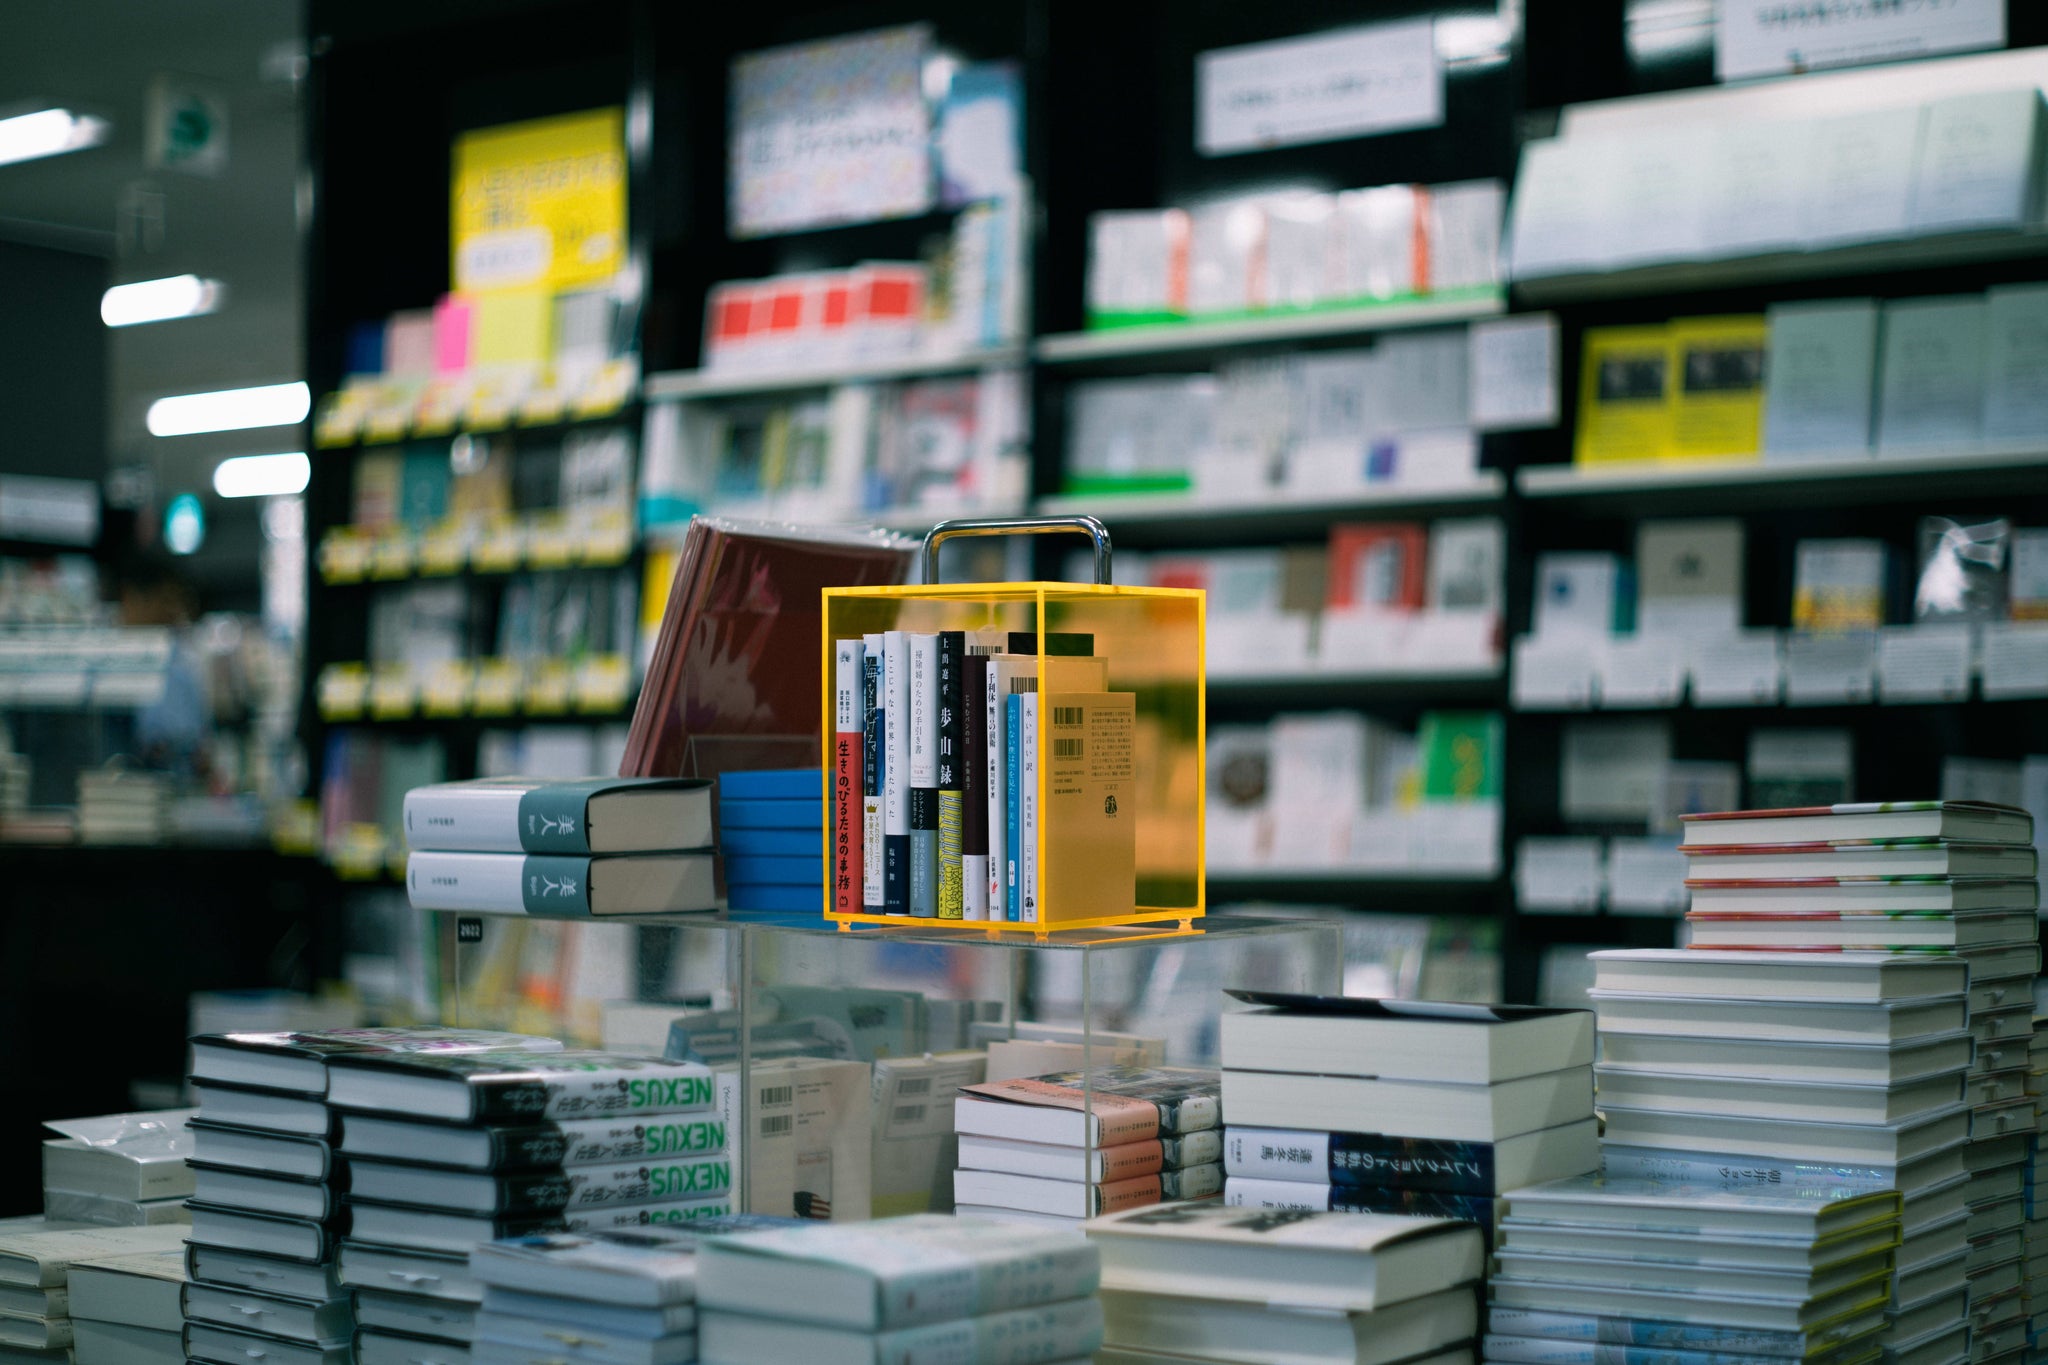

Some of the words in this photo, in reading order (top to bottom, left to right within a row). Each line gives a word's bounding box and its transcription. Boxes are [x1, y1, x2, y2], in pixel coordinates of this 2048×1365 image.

[940, 707, 952, 785] 歩山録
[540, 813, 575, 837] 美人
[838, 740, 851, 890] 生きのびるための事務
[542, 874, 577, 898] 美人
[629, 1076, 712, 1108] NEXUS
[646, 1121, 725, 1154] NEXUS
[651, 1161, 731, 1195] NEXUS
[1333, 1150, 1480, 1178] ブレイクショットの軌跡
[1718, 1166, 1782, 1184] 朝井リョウ
